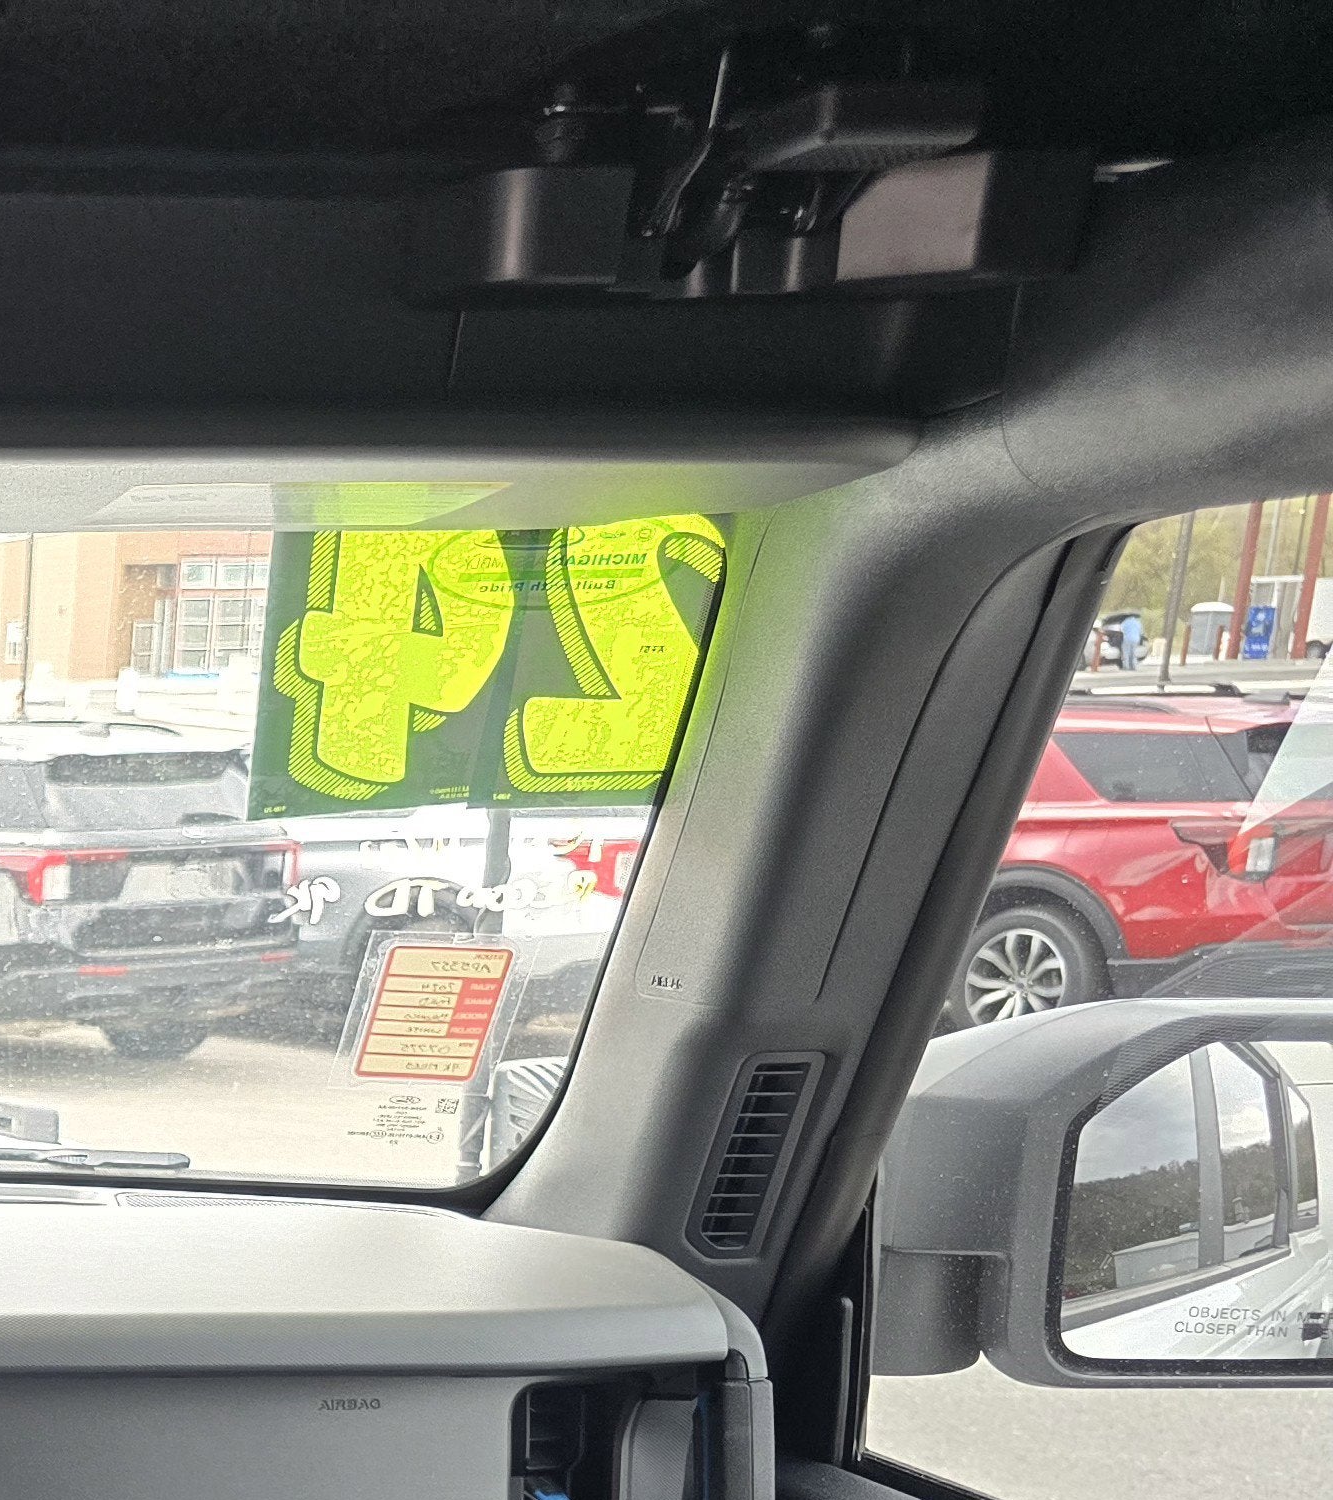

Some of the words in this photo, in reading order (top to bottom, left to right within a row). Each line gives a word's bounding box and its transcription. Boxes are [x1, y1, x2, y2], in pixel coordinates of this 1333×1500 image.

[1188, 1306, 1261, 1321] OBJECTS
[1174, 1321, 1237, 1336] CLOSER
[1246, 1325, 1288, 1338] THAN
